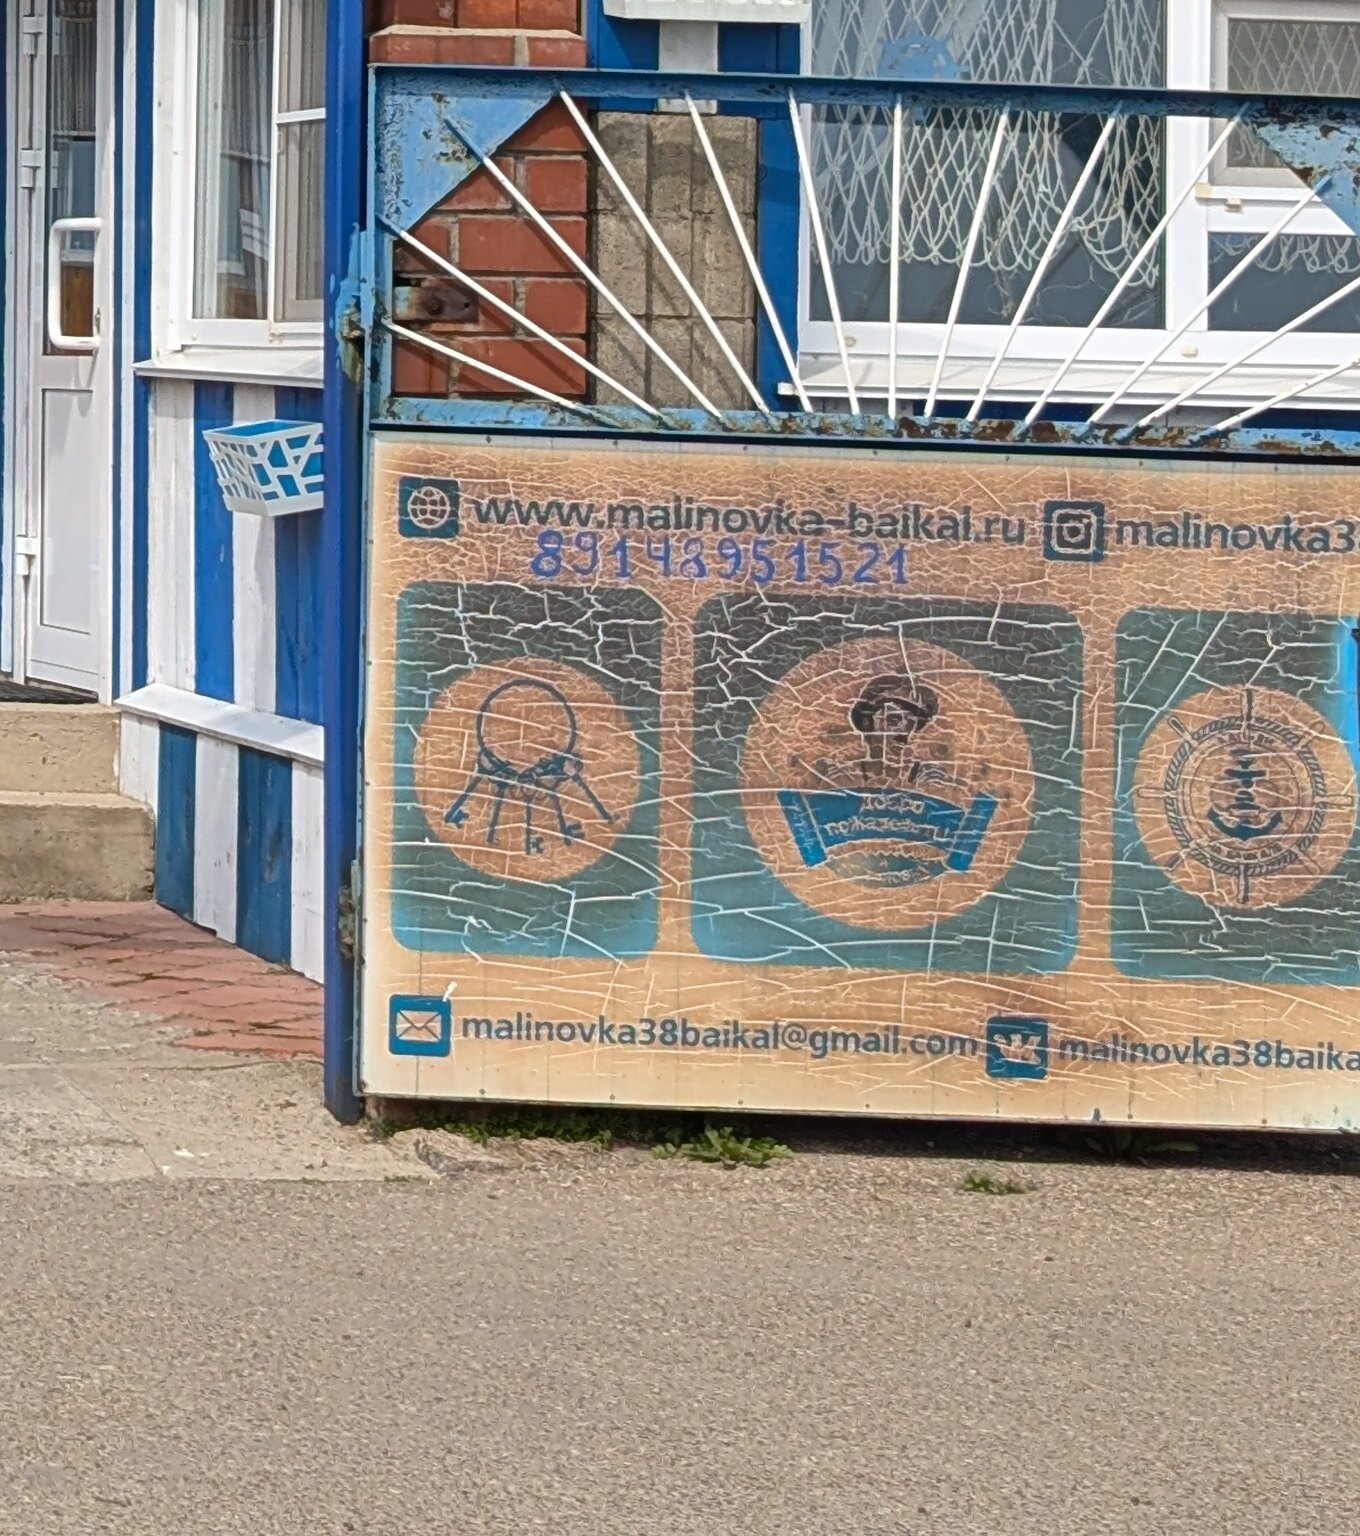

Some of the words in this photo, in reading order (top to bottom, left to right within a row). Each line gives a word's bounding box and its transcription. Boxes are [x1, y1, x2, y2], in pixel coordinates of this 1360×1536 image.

[472, 495, 1026, 544] www.malinovka-baikal.ru
[1115, 510, 1360, 554] malinovka3
[532, 529, 909, 585] 89148951521
[462, 1012, 978, 1059] malinovka38baikal@gmail.com
